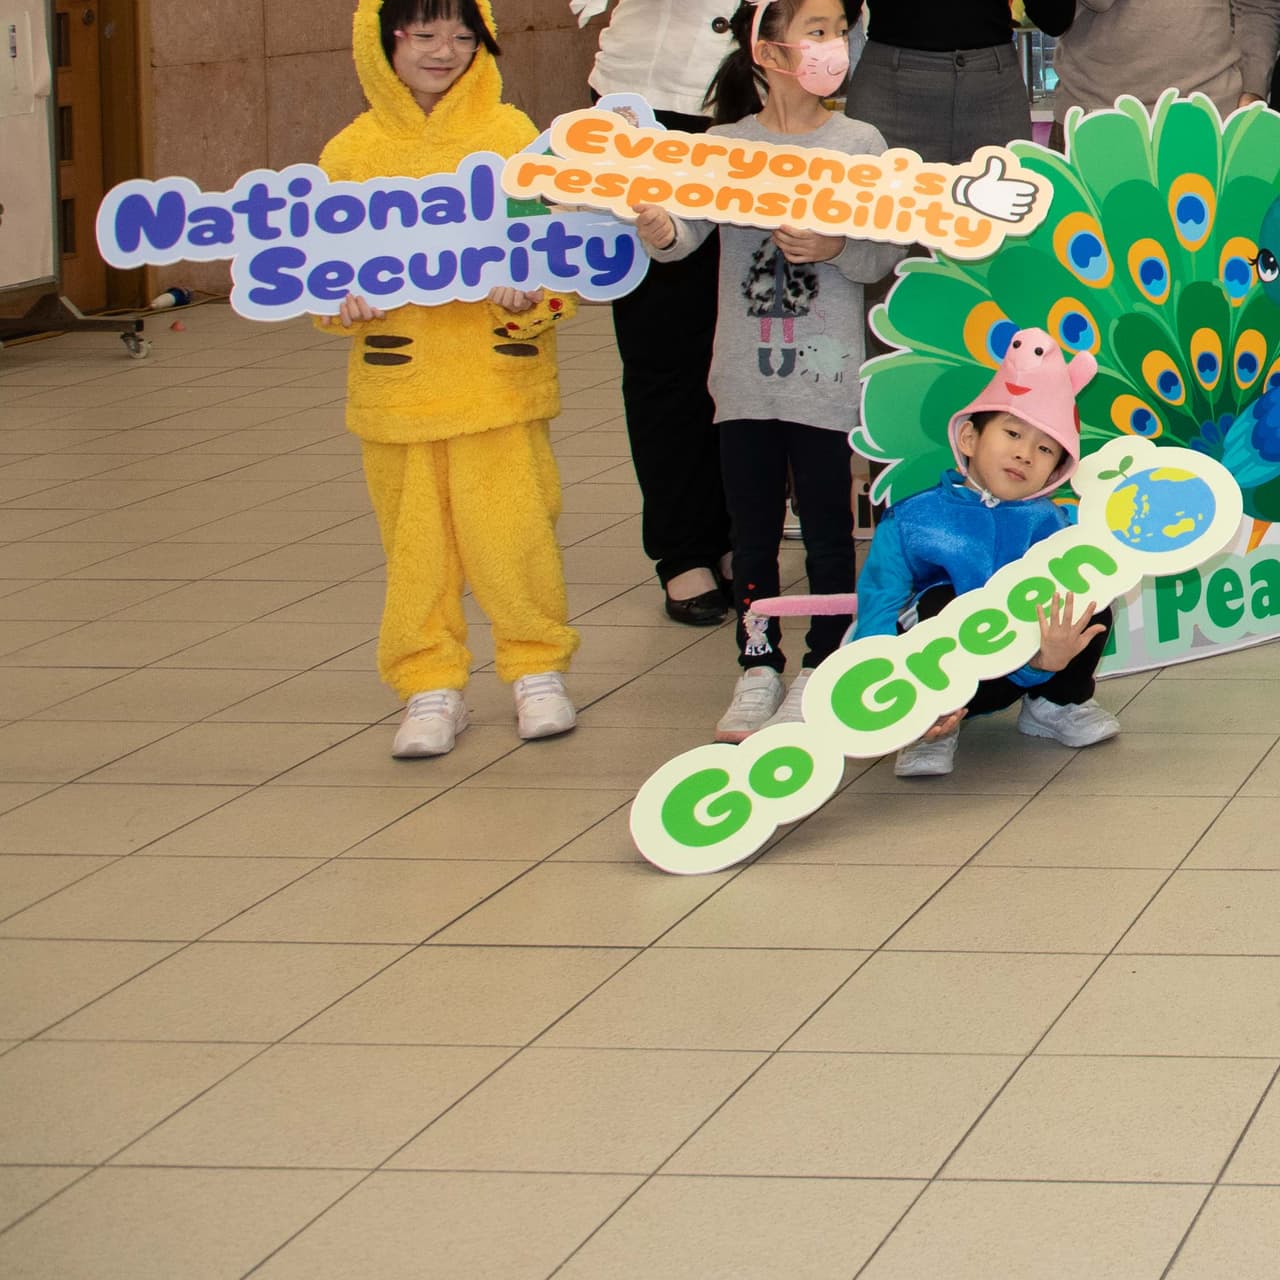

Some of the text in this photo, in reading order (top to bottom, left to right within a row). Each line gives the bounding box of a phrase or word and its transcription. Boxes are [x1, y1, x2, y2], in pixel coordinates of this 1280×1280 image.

[566, 118, 946, 196] Everyone's
[115, 164, 494, 253] National
[517, 162, 992, 248] responsibility
[249, 220, 636, 306] Security
[744, 642, 773, 656] ELSA
[661, 545, 1117, 847] Go Green
